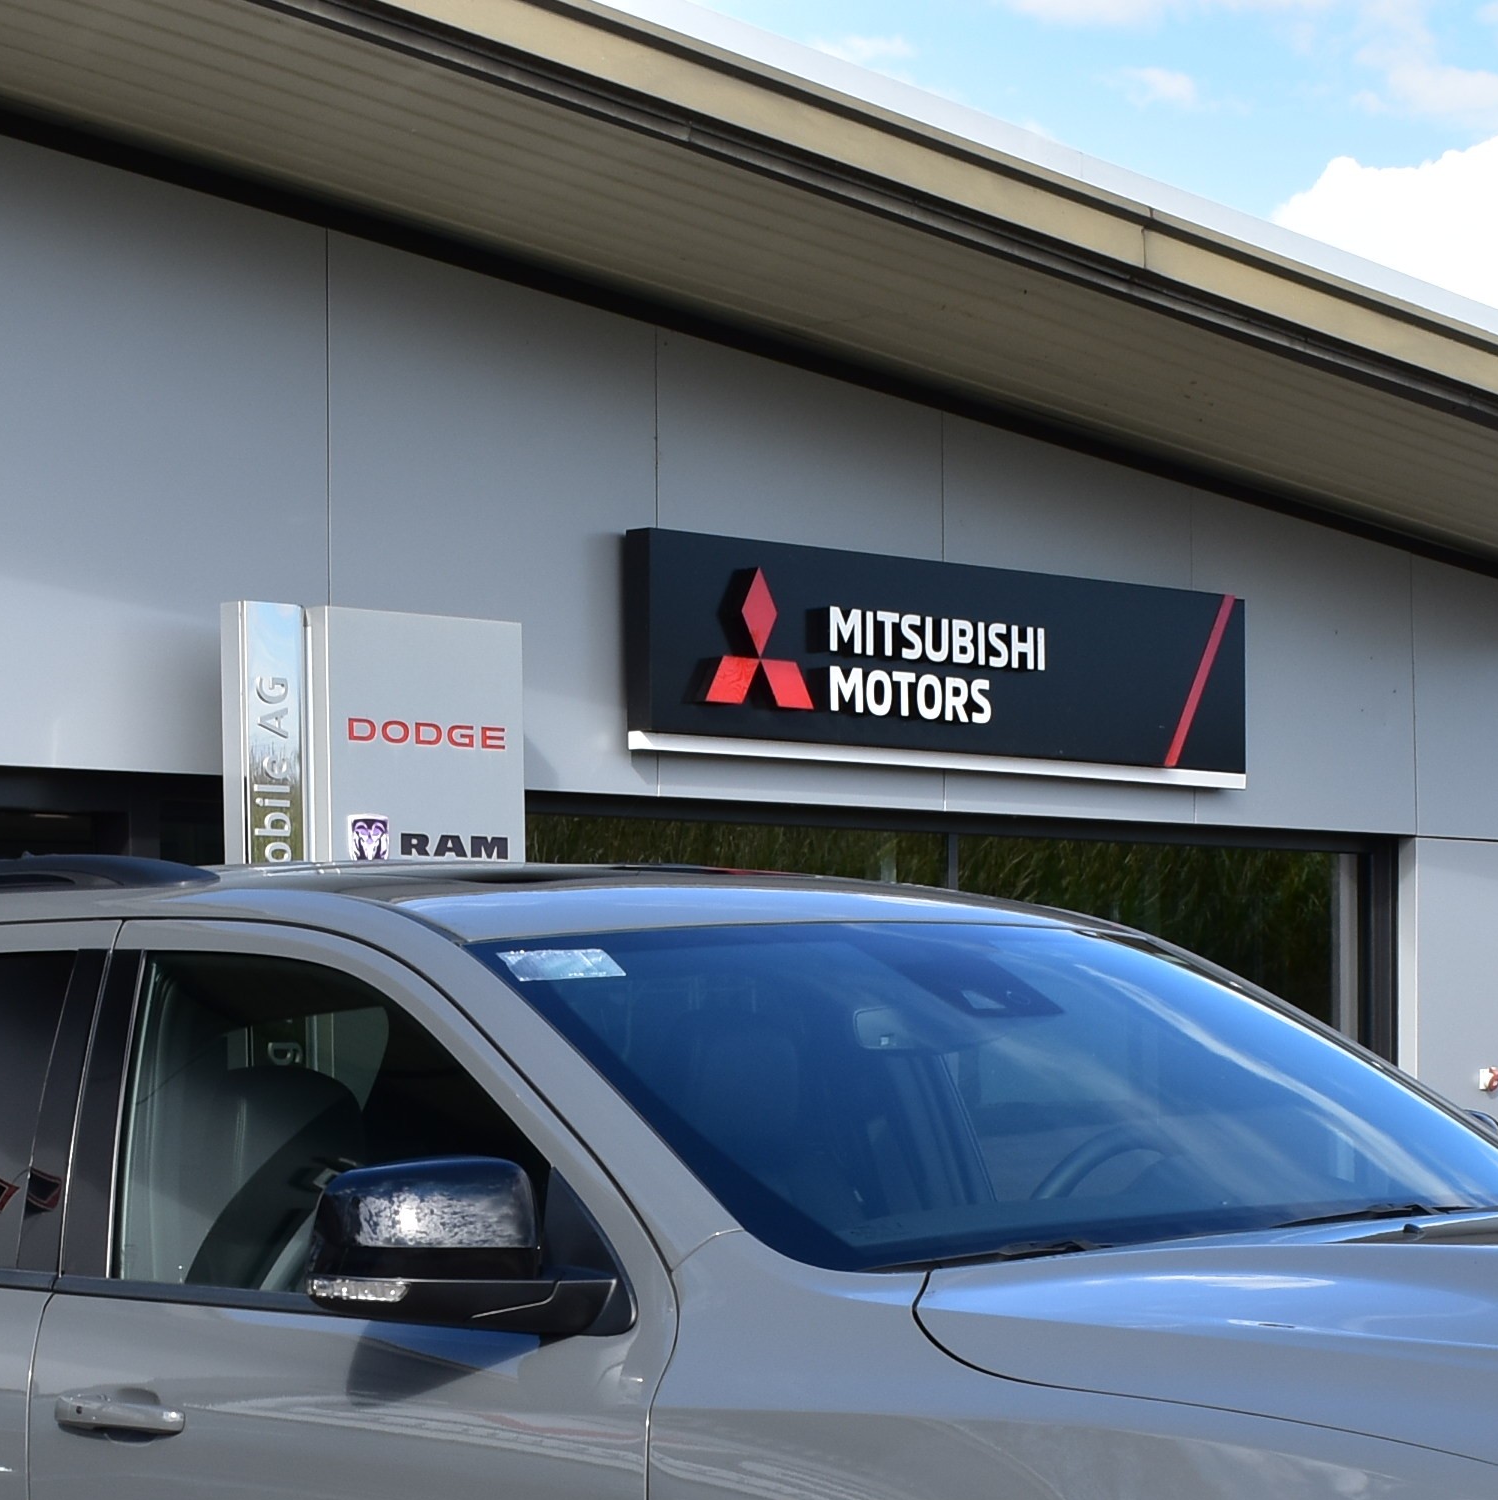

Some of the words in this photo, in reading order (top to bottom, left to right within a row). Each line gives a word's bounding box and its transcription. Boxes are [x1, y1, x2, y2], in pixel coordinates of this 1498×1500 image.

[829, 605, 1047, 672] MITSUBISHI
[255, 676, 290, 739] AG
[829, 666, 992, 725] MOTORS
[347, 717, 507, 751] DODGE
[400, 832, 509, 861] RAM
